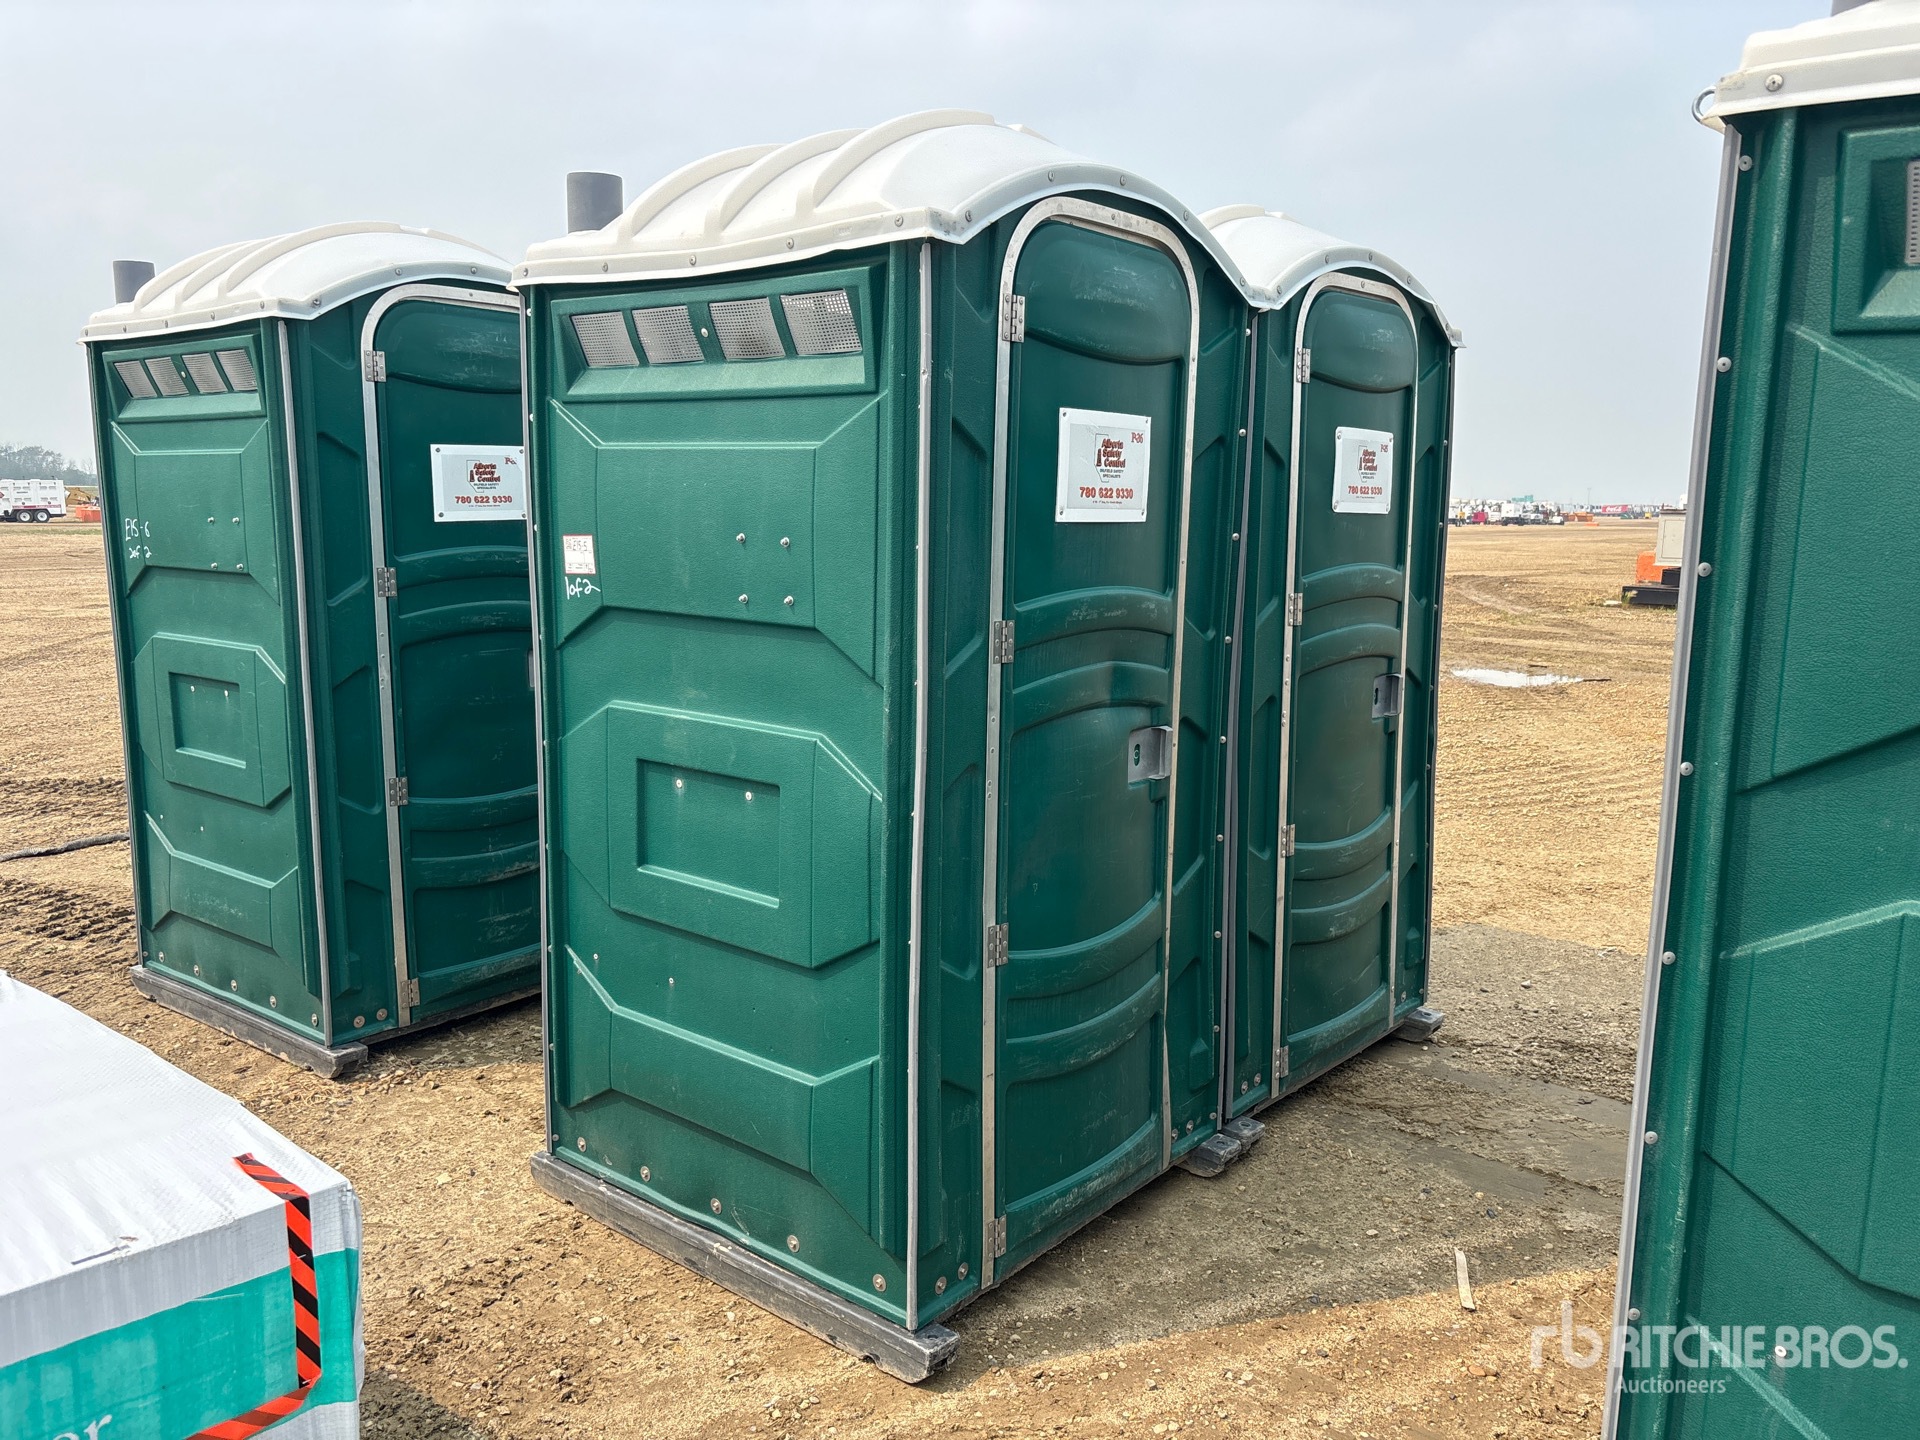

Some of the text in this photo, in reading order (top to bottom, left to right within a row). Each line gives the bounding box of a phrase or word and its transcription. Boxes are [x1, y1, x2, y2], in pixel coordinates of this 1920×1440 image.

[1101, 438, 1123, 449] Alberta
[1103, 448, 1122, 460] Safety
[1104, 459, 1126, 468] Control
[1080, 486, 1133, 499] 780 622 9330
[1348, 485, 1358, 494] 780
[1360, 486, 1369, 495] 622
